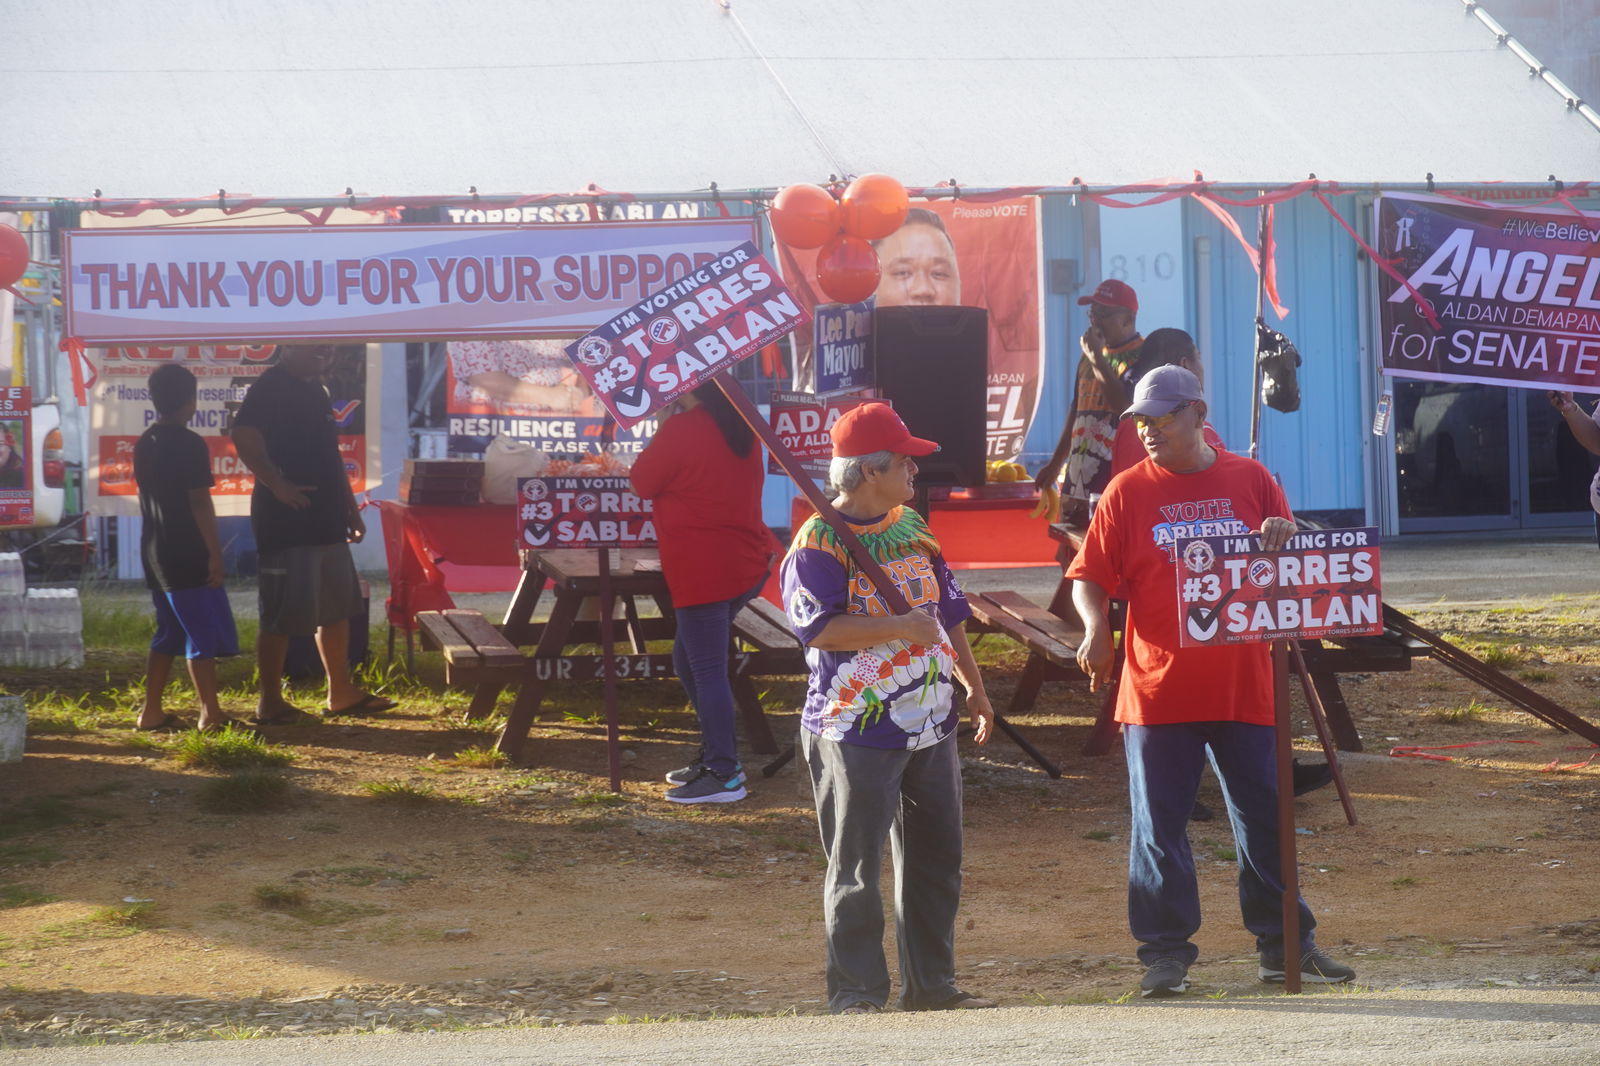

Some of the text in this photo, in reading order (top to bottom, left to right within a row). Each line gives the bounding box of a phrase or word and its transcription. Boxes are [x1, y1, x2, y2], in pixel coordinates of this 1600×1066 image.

[952, 205, 1028, 219] PleaseVOTE
[81, 251, 729, 310] THANK YOU FOR YOUR SUPPO
[1109, 254, 1176, 283] 810
[1387, 228, 1600, 310] ANGEL
[610, 249, 750, 335] I'M VOTING FOR
[820, 314, 843, 345] Lee
[1442, 302, 1600, 332] ALDAN DEMAPAN
[650, 291, 801, 392] SABLAN
[1388, 324, 1600, 376] for SENATE
[663, 316, 803, 401] PAID FOR BY COMMITTEE TO ELECT TORRES SABLAN
[823, 342, 867, 377] Mayor
[594, 355, 637, 393] #3
[450, 417, 577, 438] RESILIENCE
[595, 441, 644, 454] VOTE
[782, 436, 800, 448] OY
[556, 478, 630, 489] I'M VOTIN
[521, 501, 554, 520] #3
[556, 493, 653, 513] TORRE
[1160, 498, 1235, 524] VOTE
[557, 521, 658, 542] SABLA
[1156, 520, 1244, 546] ARLENE
[1223, 532, 1367, 553] I'M VTING FOR
[1183, 573, 1222, 602] #3
[1226, 594, 1378, 633] SABLAN
[1263, 632, 1298, 640] COMMITTEE
[1351, 626, 1376, 634] SABLAN
[535, 658, 573, 680] UR
